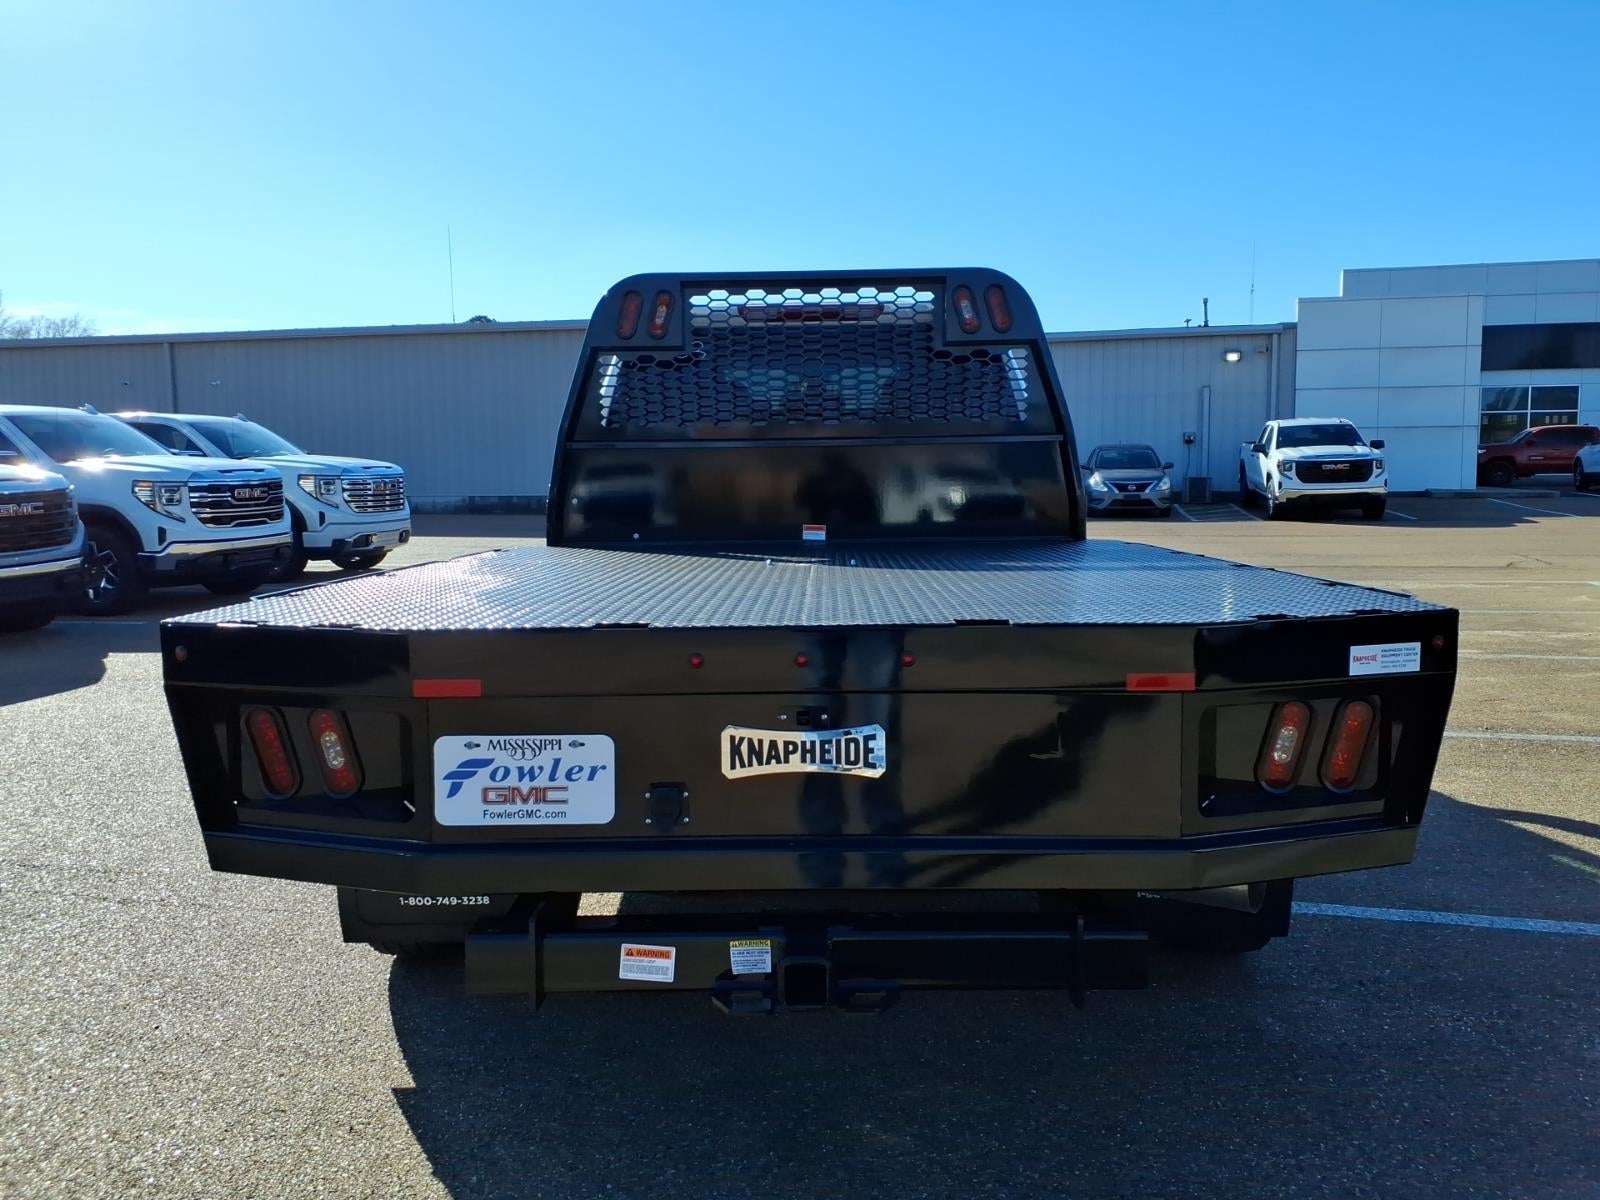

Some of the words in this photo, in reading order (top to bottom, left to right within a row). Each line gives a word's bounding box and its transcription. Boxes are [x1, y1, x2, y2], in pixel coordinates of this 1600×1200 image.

[234, 487, 268, 499] GMC
[1353, 654, 1377, 663] KNAPHEIDE
[487, 738, 562, 761] MISSISSIPPI
[729, 733, 877, 770] KNAPHEIDE
[442, 757, 608, 799] Fowler
[481, 785, 569, 805] GMC
[483, 809, 567, 819] FowlerGMC.com
[399, 896, 490, 906] 1-800-749-3238
[635, 948, 671, 959] WARNING
